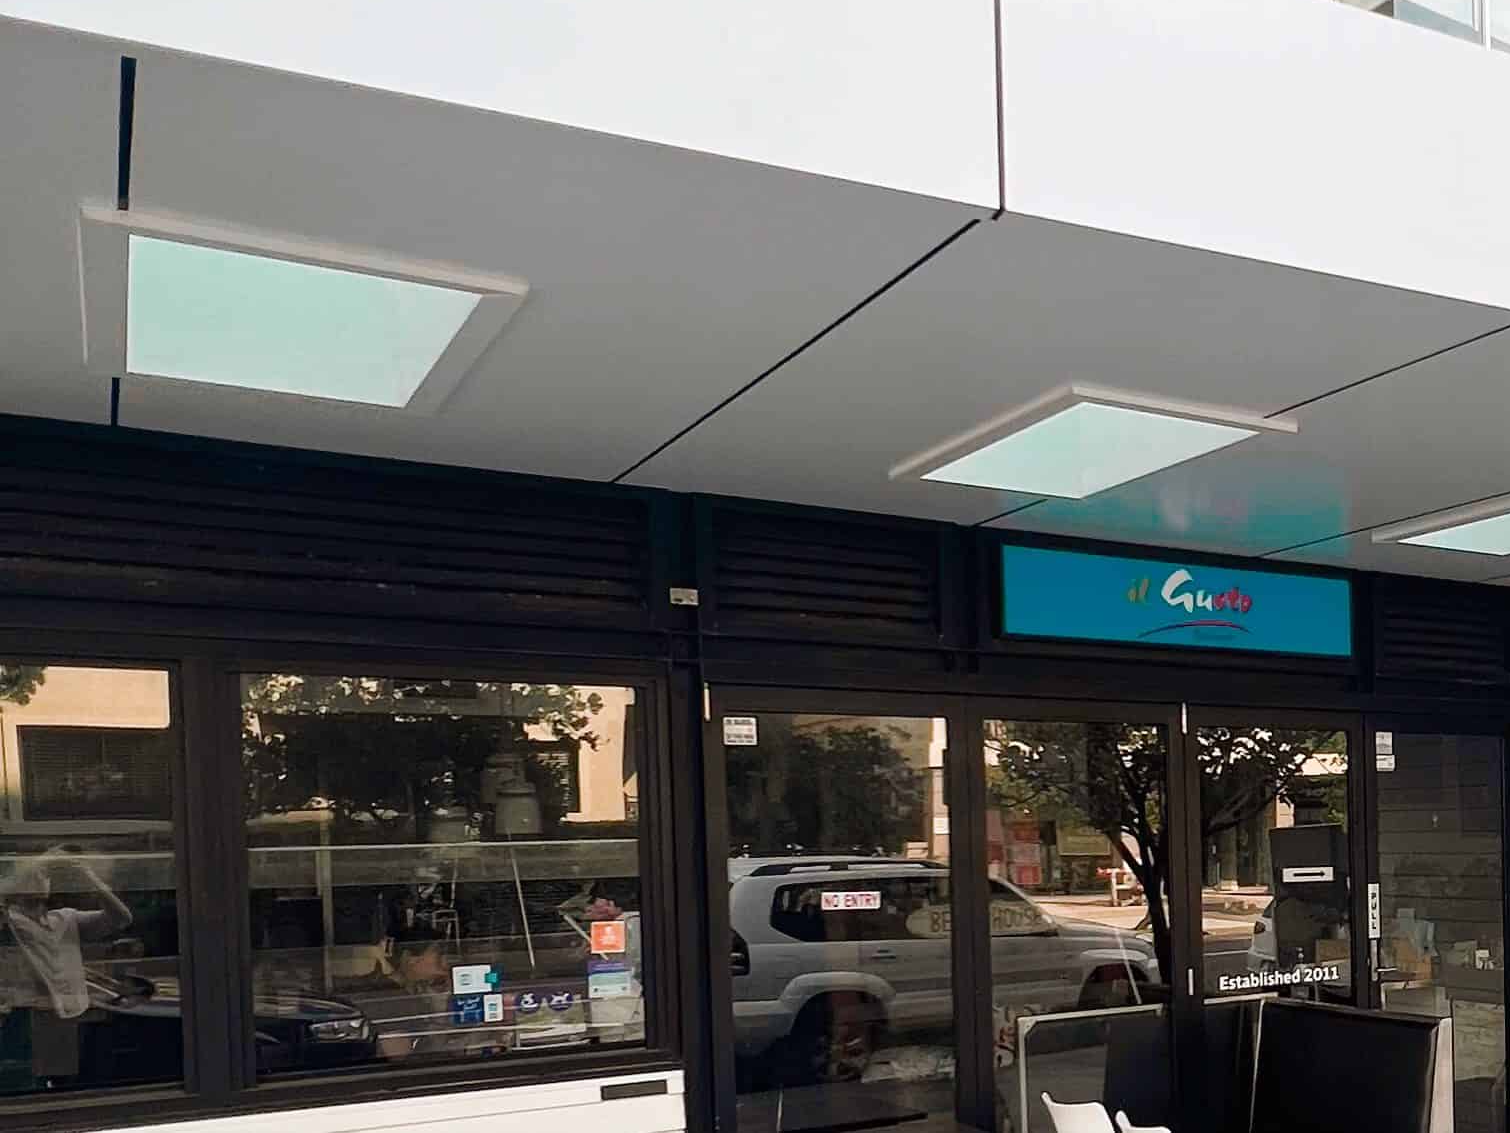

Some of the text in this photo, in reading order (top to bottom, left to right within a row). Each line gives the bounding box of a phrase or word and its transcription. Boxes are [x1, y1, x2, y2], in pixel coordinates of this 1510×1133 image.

[1161, 569, 1253, 613] Gusto
[824, 893, 879, 908] NO ENTRY
[1219, 967, 1339, 990] Established 2011
